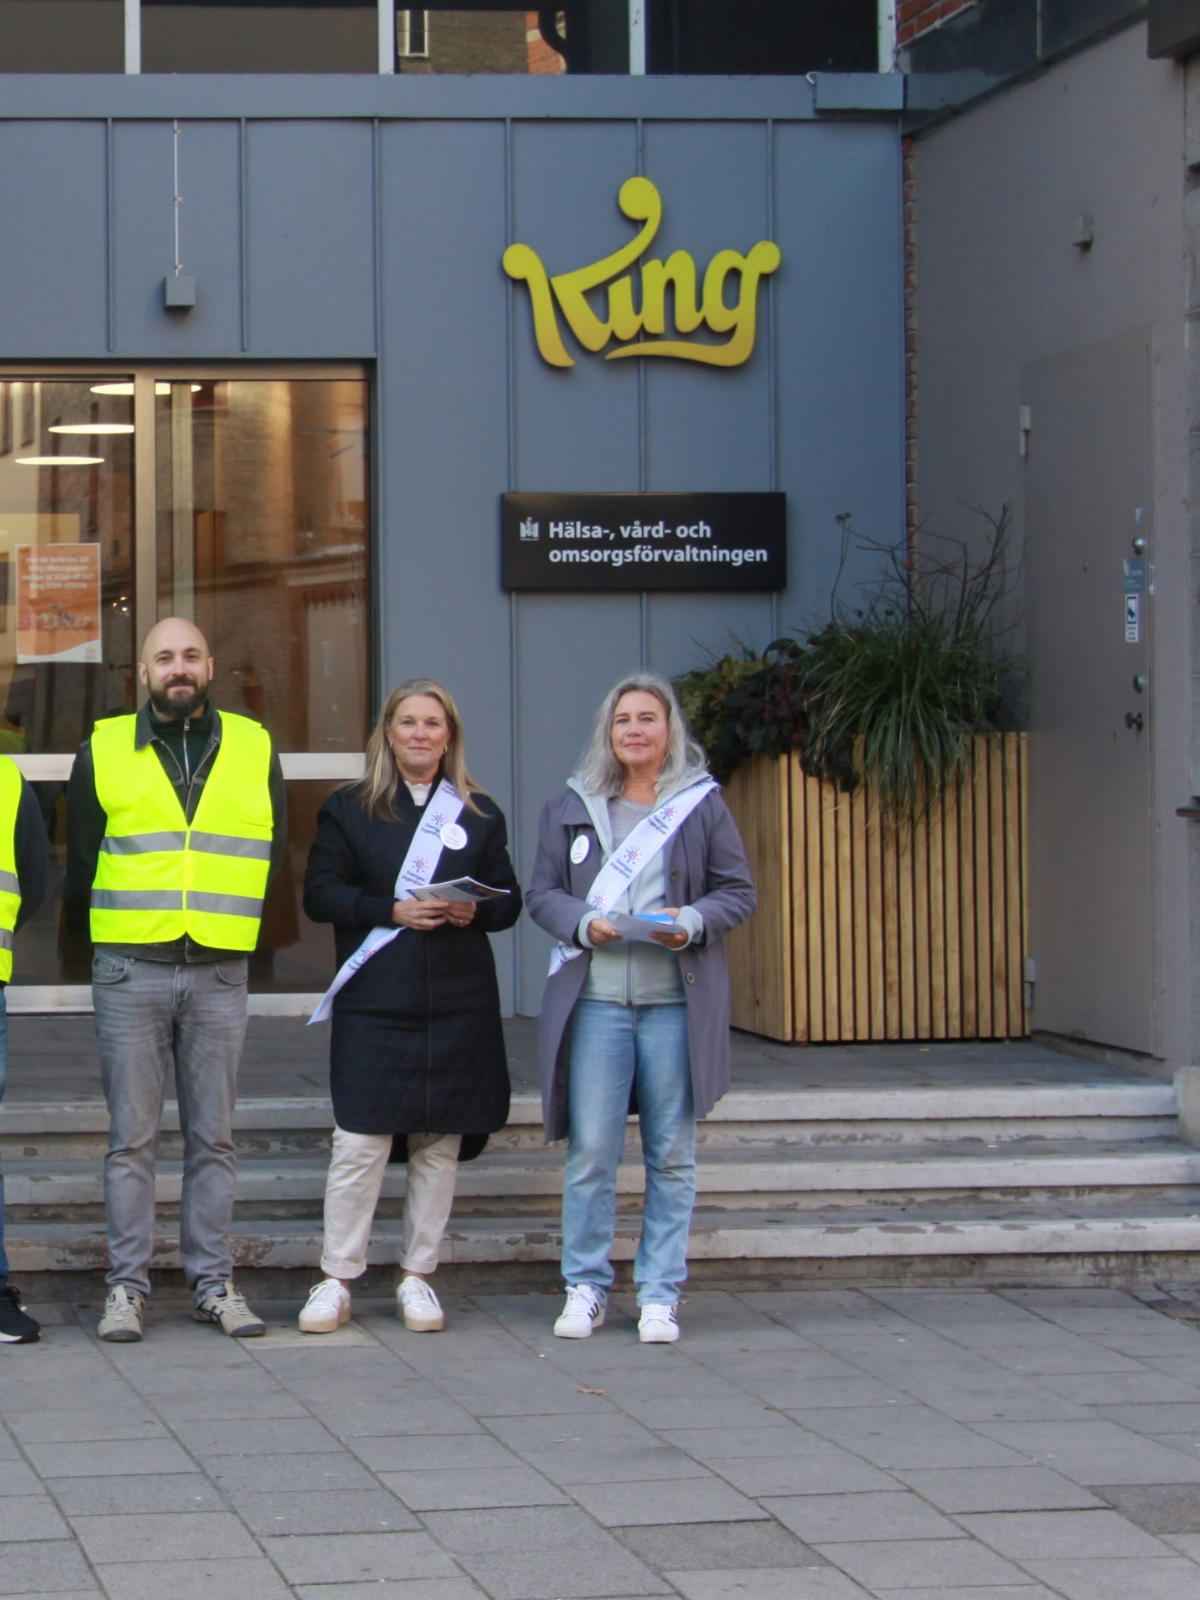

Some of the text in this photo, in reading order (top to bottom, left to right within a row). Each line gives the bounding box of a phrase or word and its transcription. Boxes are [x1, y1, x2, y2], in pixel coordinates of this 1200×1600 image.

[503, 176, 781, 367] King
[548, 520, 711, 541] Hälsa-, vård- och
[548, 545, 768, 567] omsorgsförvaltningen
